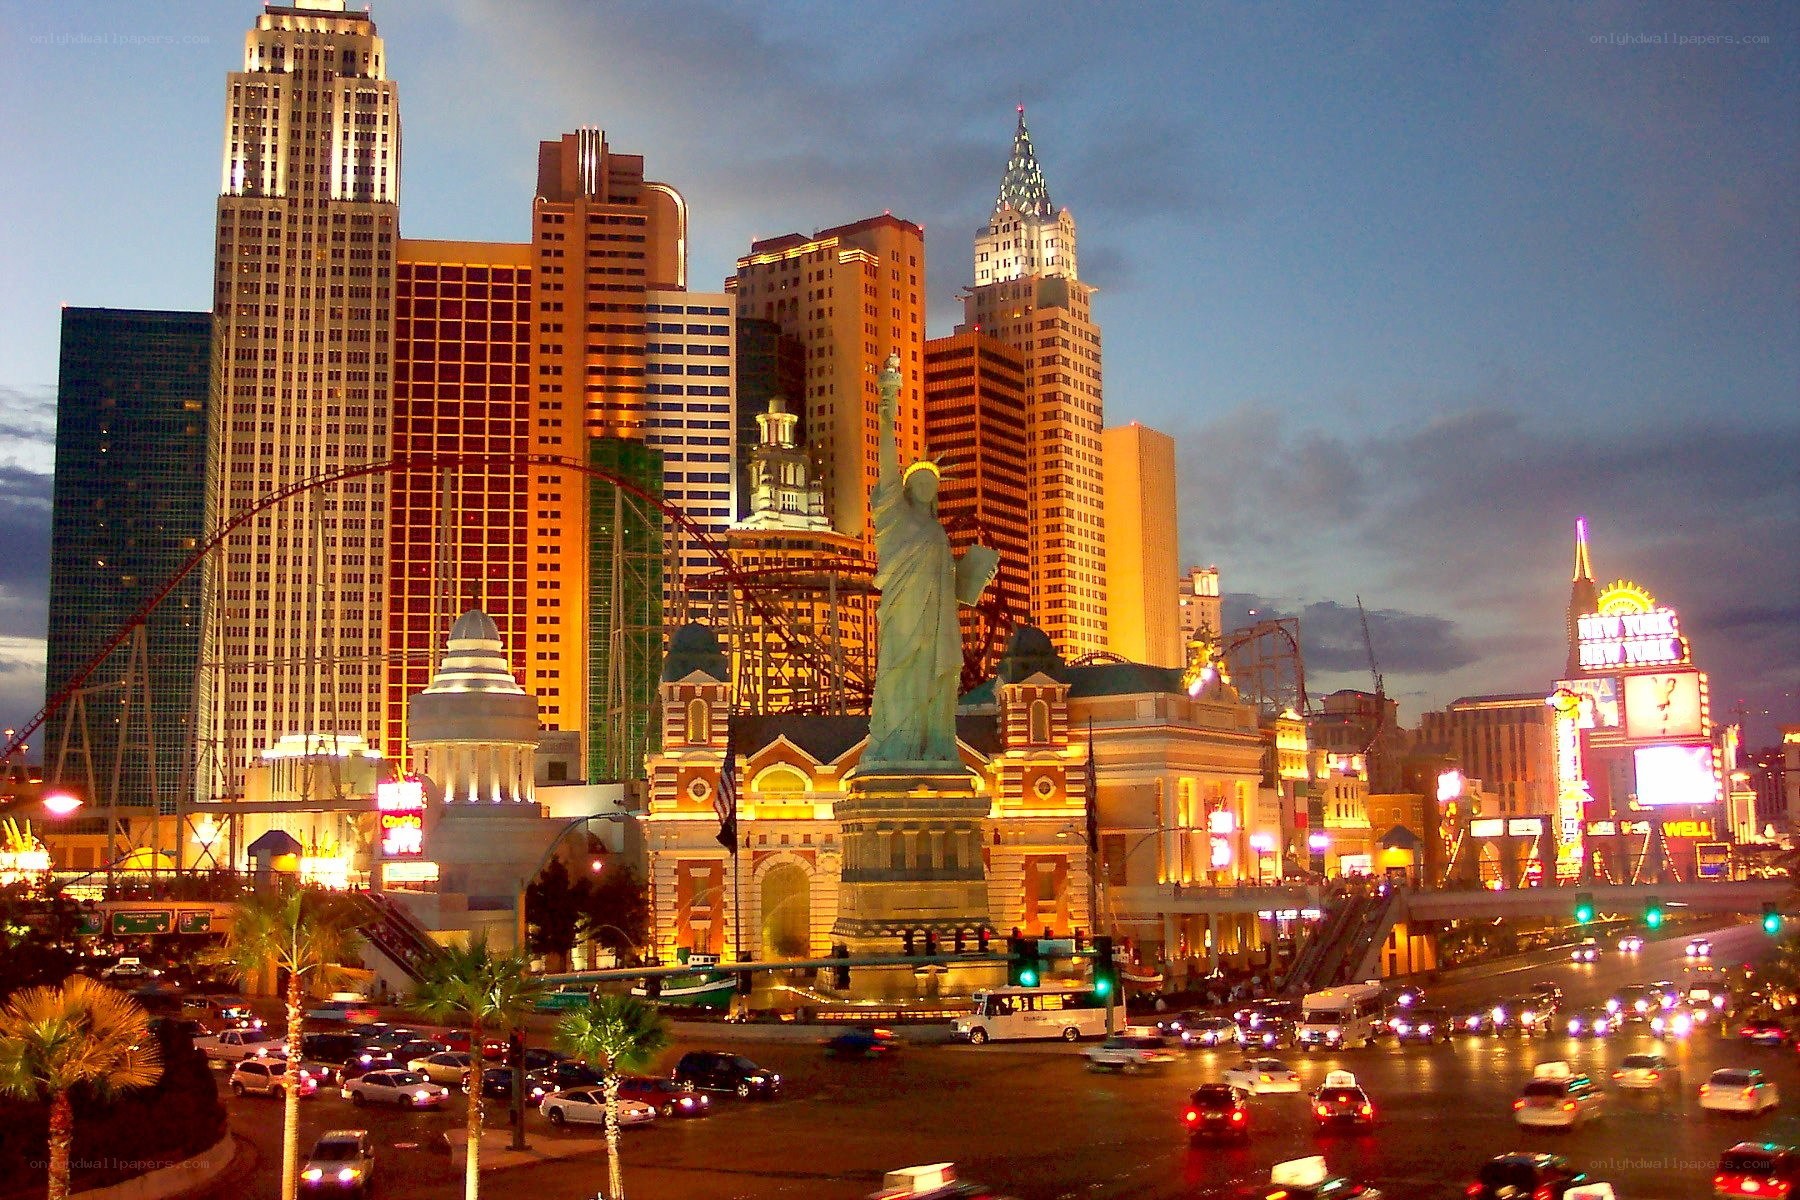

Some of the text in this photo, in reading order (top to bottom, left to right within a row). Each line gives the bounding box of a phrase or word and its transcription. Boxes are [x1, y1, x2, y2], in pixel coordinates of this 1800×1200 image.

[1577, 612, 1673, 639] NEW YORK
[1579, 638, 1675, 665] NEW YORK
[1662, 821, 1710, 837] WELL
